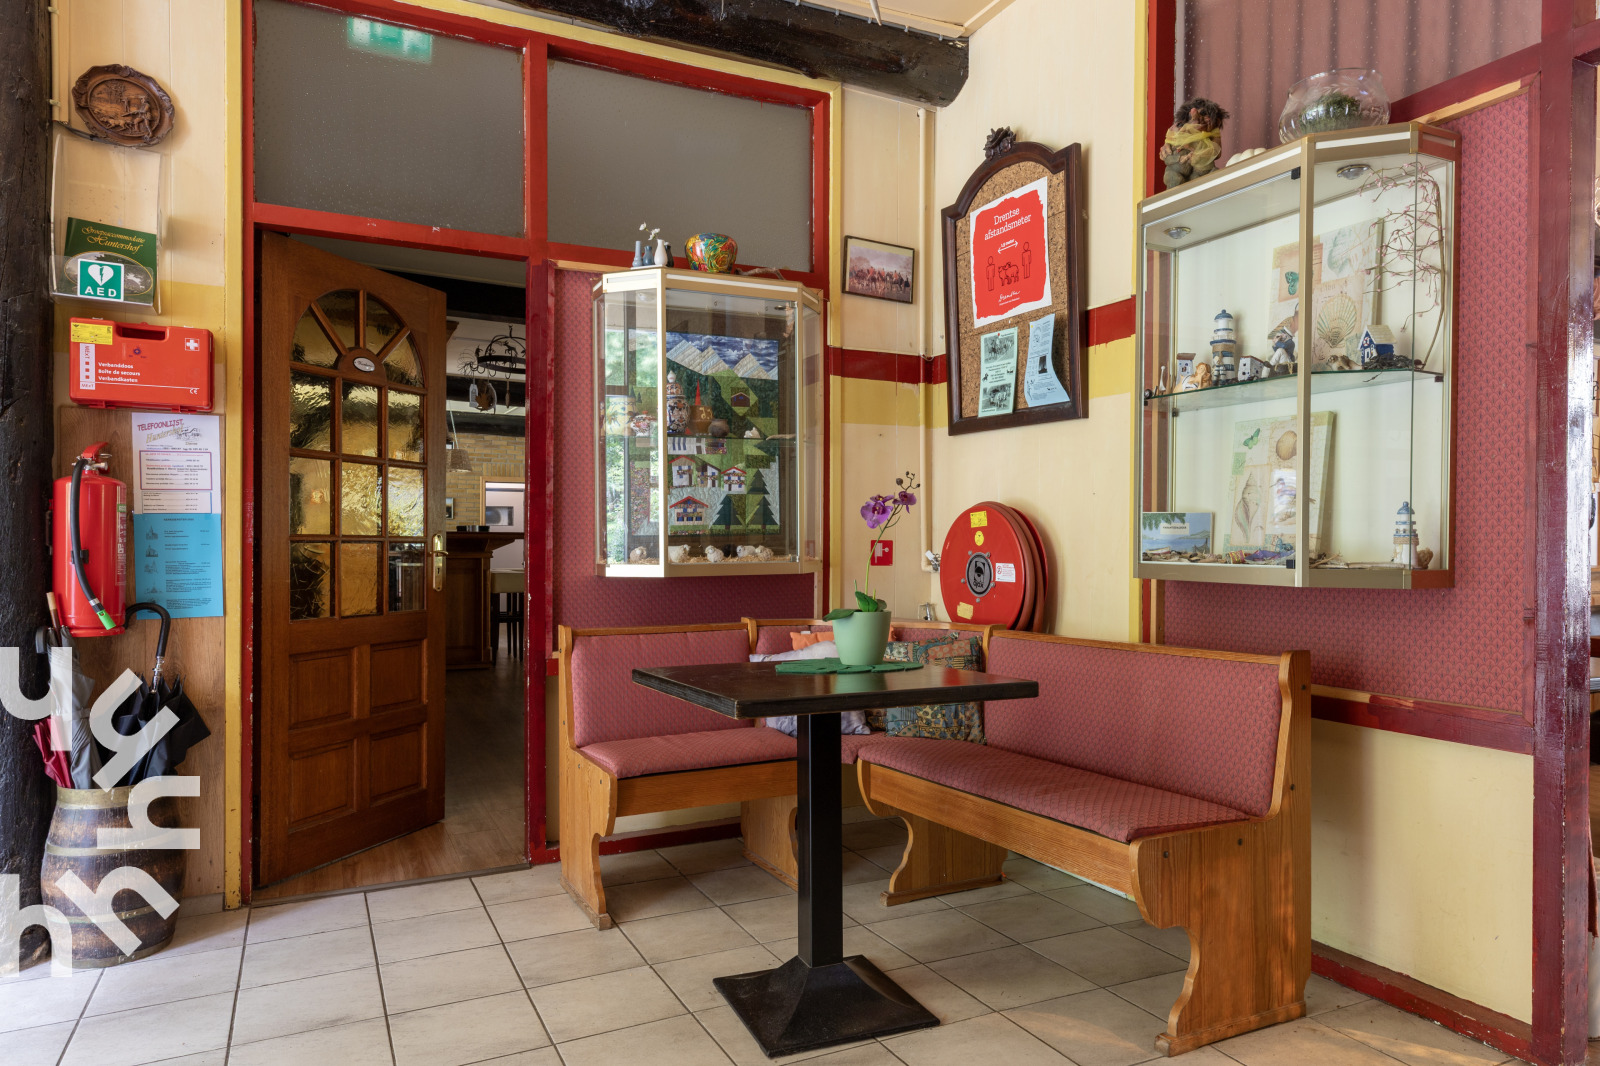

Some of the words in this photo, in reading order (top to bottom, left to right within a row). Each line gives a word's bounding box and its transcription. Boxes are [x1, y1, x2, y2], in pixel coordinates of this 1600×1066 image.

[994, 208, 1020, 226] Drentse
[984, 214, 1032, 241] afstandsmeter
[86, 235, 144, 254] Huntershof
[84, 286, 117, 297] AED
[98, 361, 134, 369] Verbanddoos
[98, 375, 139, 383] Verbandkasten
[137, 418, 184, 432] TELEFOONLIJST
